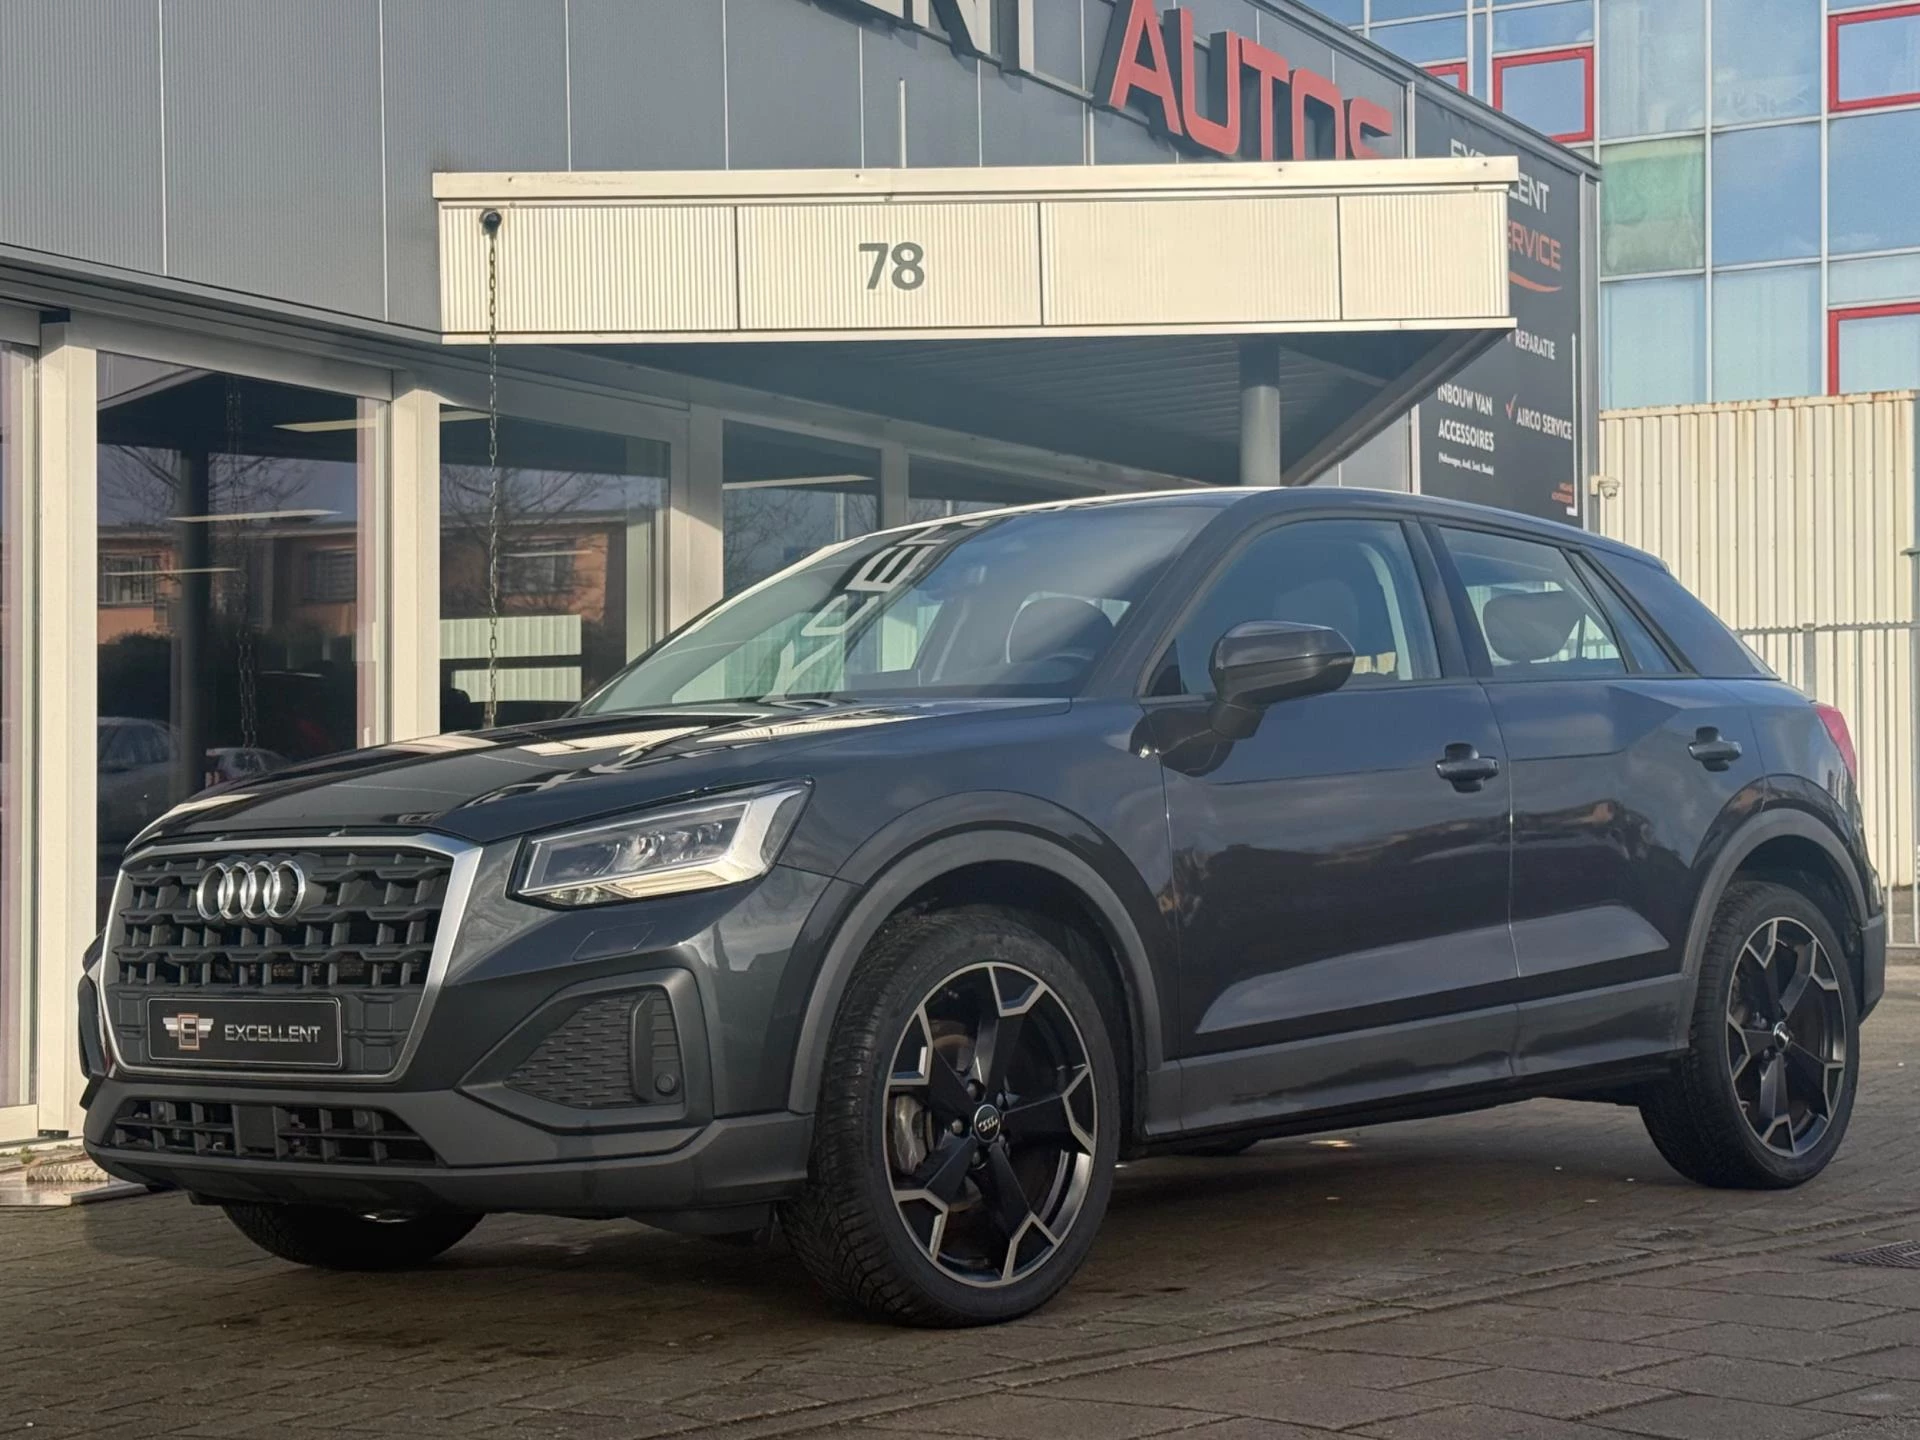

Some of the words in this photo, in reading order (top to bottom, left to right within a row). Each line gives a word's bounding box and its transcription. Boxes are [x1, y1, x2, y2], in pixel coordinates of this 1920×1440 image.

[1109, 0, 1392, 160] AUTOS
[859, 242, 925, 290] 78
[1515, 329, 1556, 360] REPARATIE
[1437, 383, 1474, 411] INBOUW
[1475, 392, 1493, 416] VAN
[1438, 418, 1494, 452] ACCESSOIRES
[1516, 407, 1542, 431] AIRCO
[1542, 413, 1572, 440] SERVICE
[224, 1024, 321, 1043] EXCELLENT
